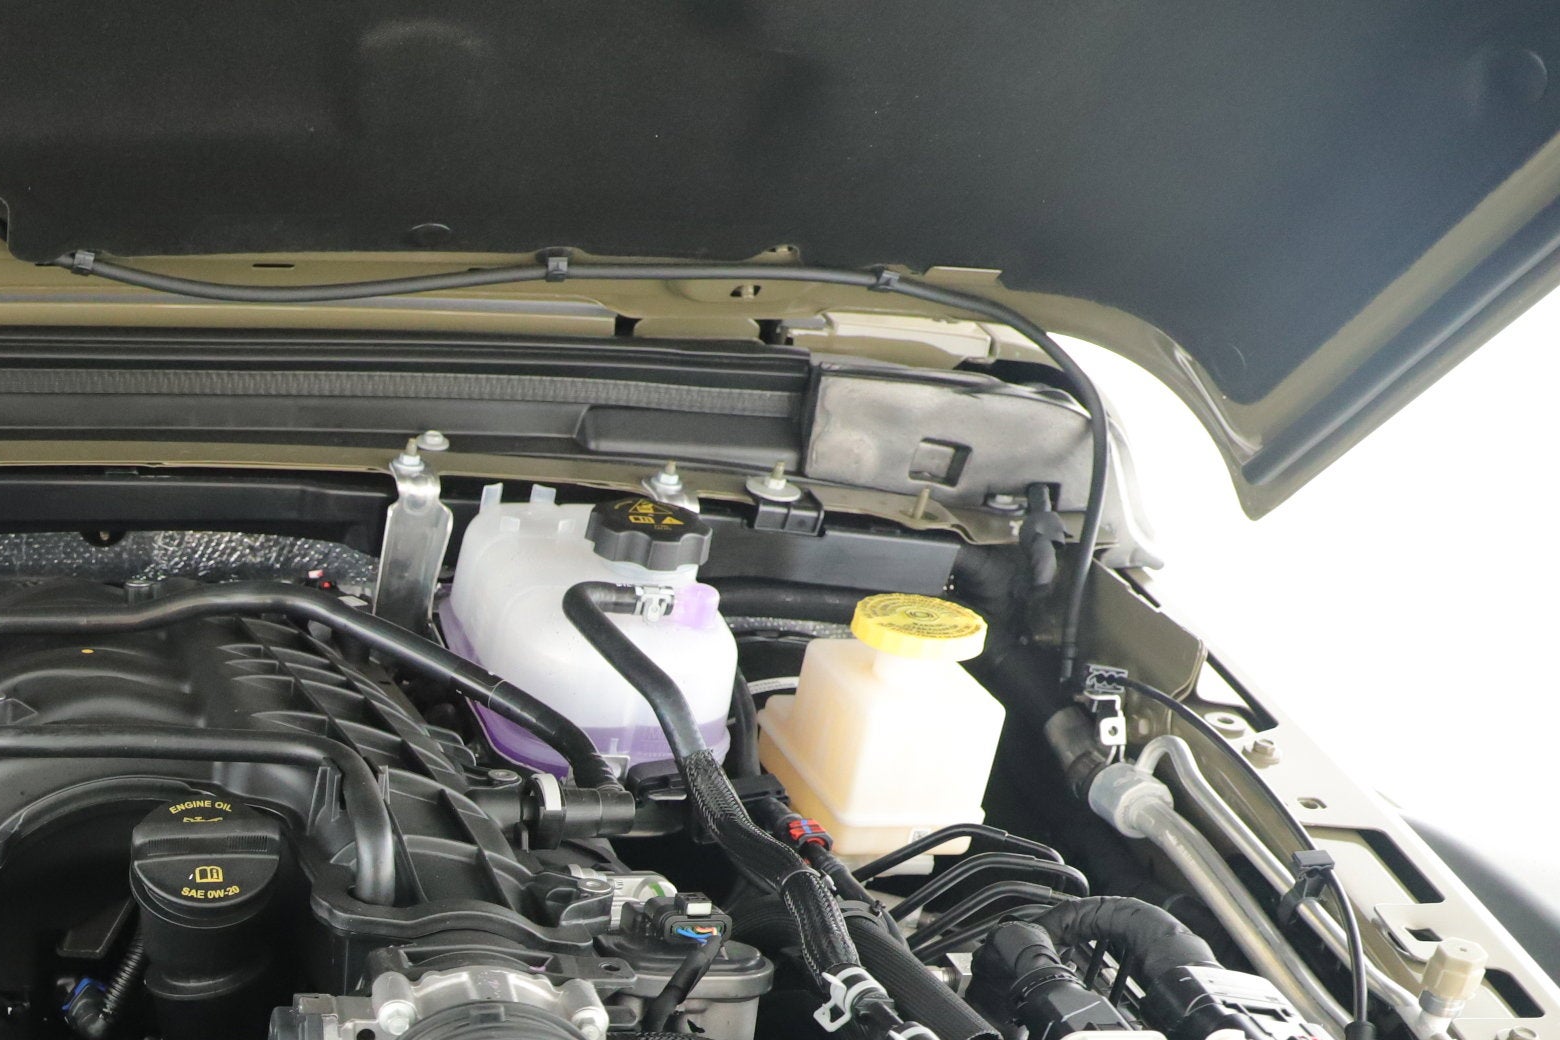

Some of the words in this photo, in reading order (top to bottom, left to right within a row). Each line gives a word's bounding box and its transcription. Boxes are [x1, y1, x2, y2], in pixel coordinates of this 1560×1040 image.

[169, 800, 211, 814] ENGINE
[215, 801, 232, 812] OIL
[181, 886, 205, 898] SAE
[207, 886, 240, 898] 0W-20
